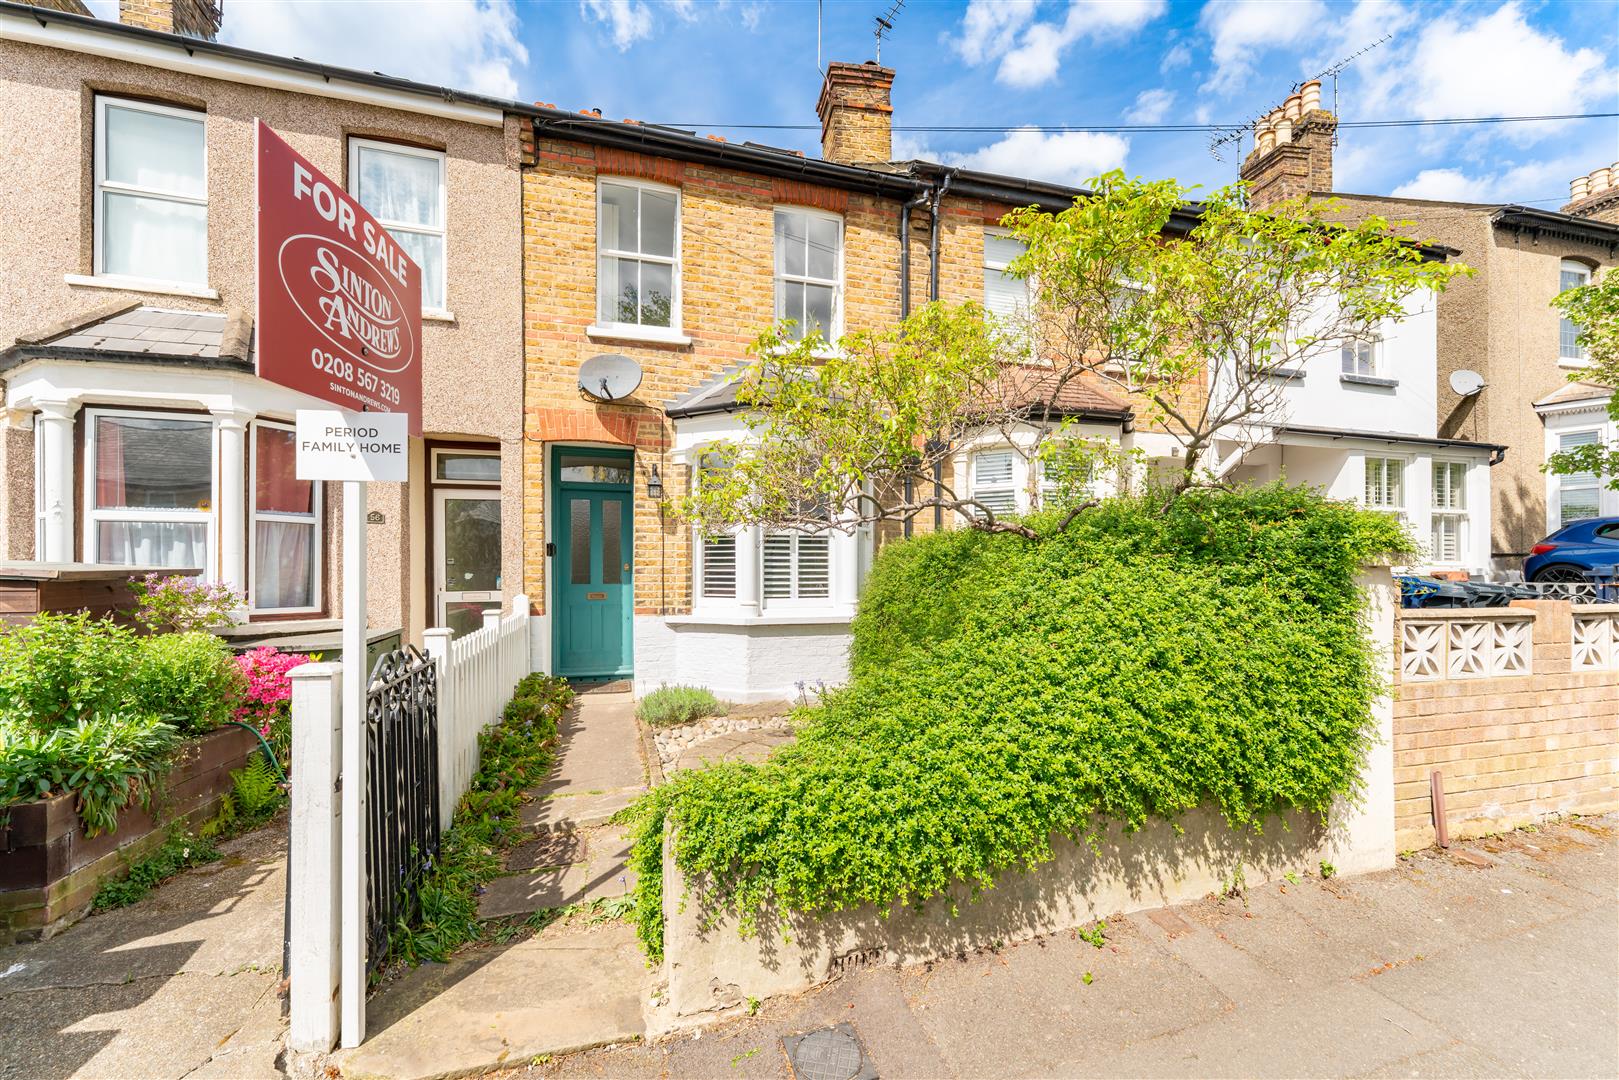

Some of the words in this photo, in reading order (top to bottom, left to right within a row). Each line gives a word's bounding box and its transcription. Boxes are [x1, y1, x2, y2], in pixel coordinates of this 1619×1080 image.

[294, 161, 356, 241] FOR
[363, 220, 407, 288] SALE
[310, 247, 393, 320] SINTON
[319, 294, 400, 353] ANDREWS
[311, 348, 353, 382] 0208
[356, 367, 379, 393] 567
[380, 380, 400, 405] 3219
[329, 382, 391, 413] SINTONANDREWS.COM
[302, 441, 355, 452] FAMILY
[359, 443, 401, 454] HOME
[325, 427, 378, 438] PERIOD
